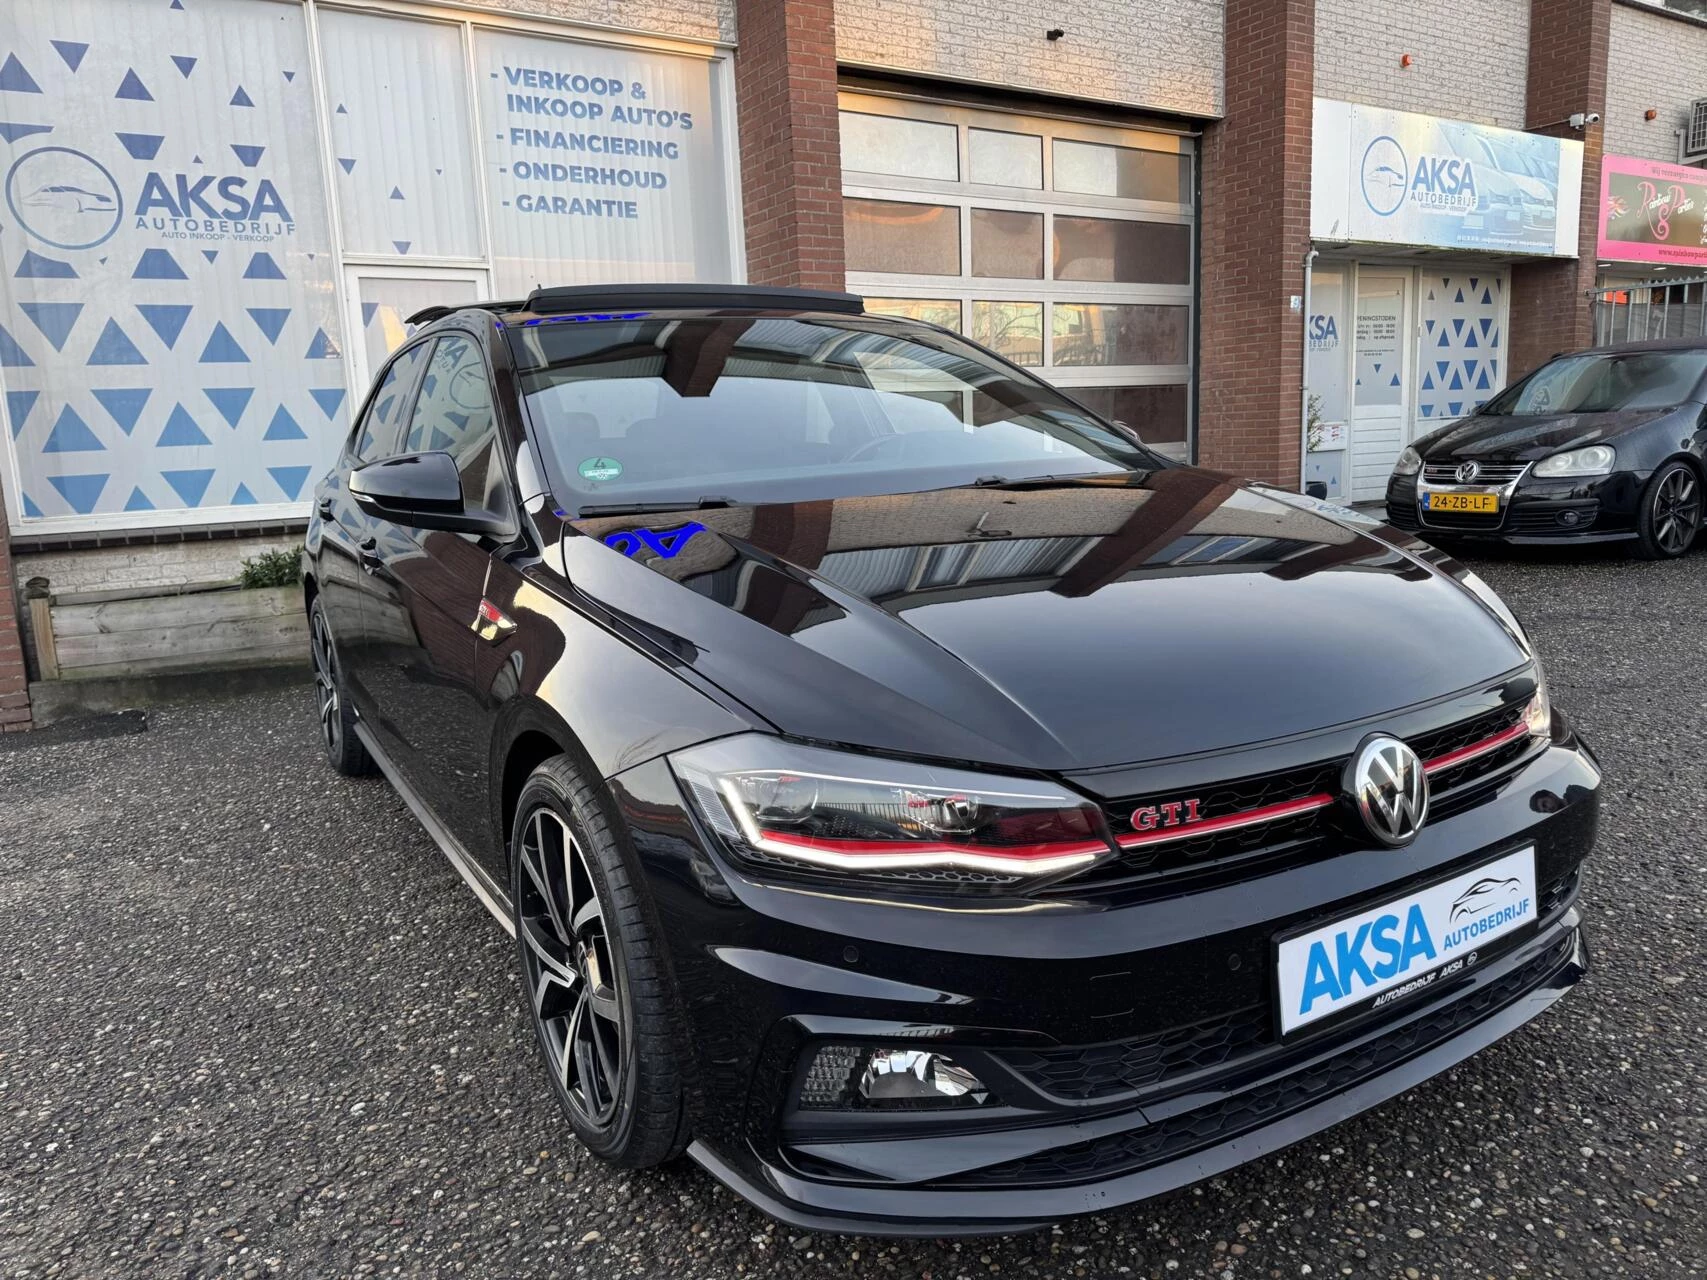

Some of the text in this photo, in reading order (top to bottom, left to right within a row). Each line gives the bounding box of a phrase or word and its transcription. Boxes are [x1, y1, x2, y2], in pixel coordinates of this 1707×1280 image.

[503, 66, 624, 97] VERKOOP
[630, 81, 647, 100] &
[506, 93, 694, 131] INKOOP AUTO'S
[509, 127, 680, 160] FINANCIERING
[512, 160, 668, 190] ONDERHOUD
[1411, 156, 1477, 197] AKSA
[134, 171, 294, 223] AKSA
[515, 193, 639, 219] GARANTIE
[1411, 191, 1477, 207] AUTOBEDRIJF
[135, 217, 296, 236] AUTOBEDRIJF
[161, 231, 187, 240] AUTO
[188, 232, 226, 241] INKOOP
[232, 233, 275, 243] VERKOOP
[1433, 494, 1491, 510] 24-ZB-LF
[1130, 798, 1201, 832] GTI
[1443, 898, 1531, 951] AUTOBEDRIJF
[1299, 903, 1437, 1016] AKSA
[1372, 958, 1464, 1009] AUTOBEDRIJF AKSA
